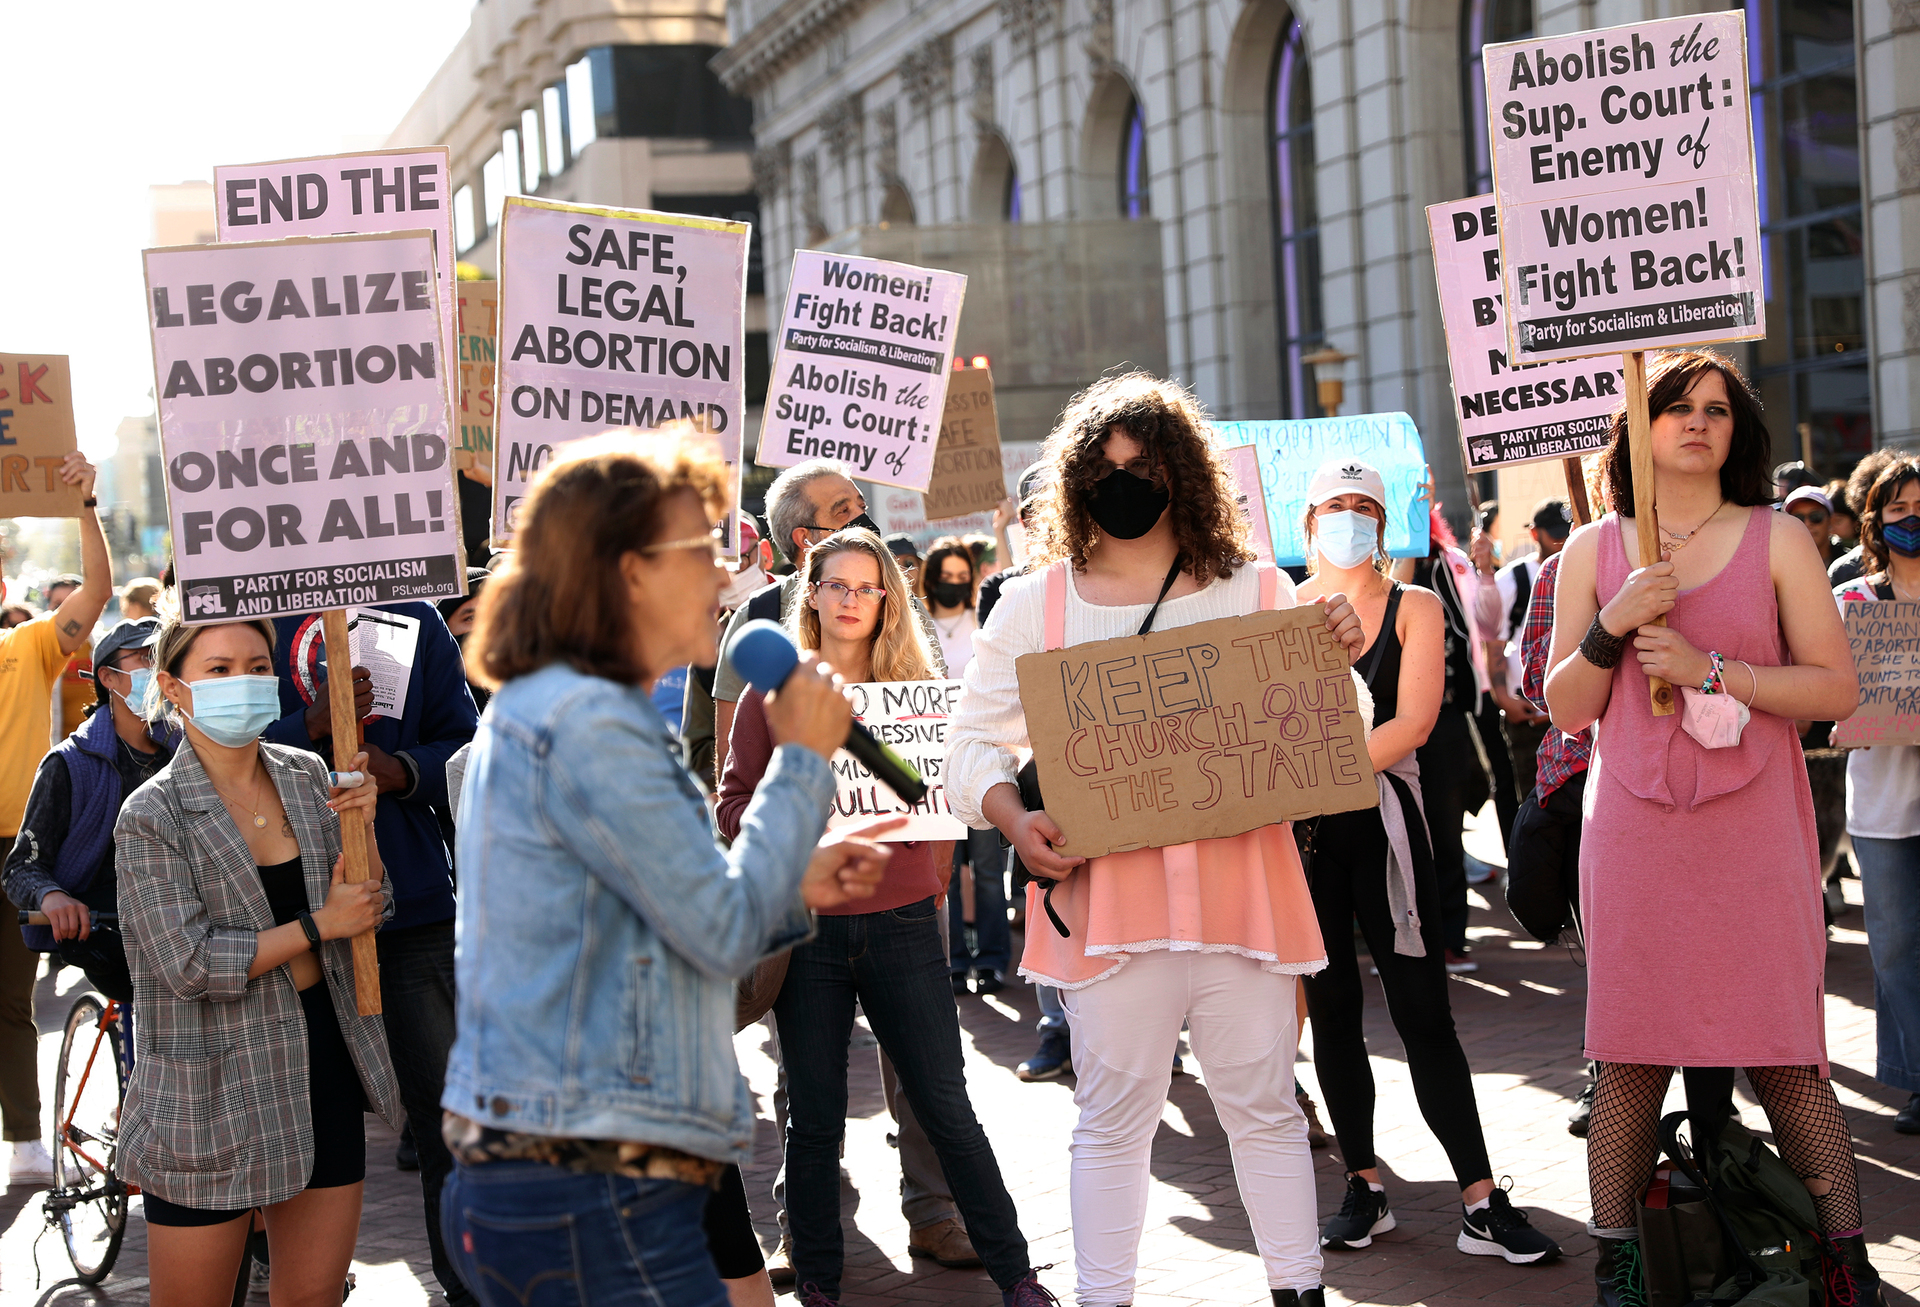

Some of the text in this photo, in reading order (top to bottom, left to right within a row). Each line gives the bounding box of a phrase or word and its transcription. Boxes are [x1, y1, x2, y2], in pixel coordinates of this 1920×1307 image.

[1509, 22, 1720, 91] Abolish the
[1502, 100, 1587, 142] Sup.
[1530, 116, 1710, 184] Enemy of
[226, 164, 439, 226] END THE
[1540, 187, 1708, 247] Women!
[565, 223, 687, 284] SAFE,
[1518, 237, 1745, 311] Fight Back!
[153, 270, 431, 328] LEGALIZE
[558, 274, 695, 328] LEGAL
[823, 260, 933, 303] Women!
[793, 293, 948, 342] Fight Back!
[1528, 300, 1744, 342] Party for Socialism & Liberation
[162, 342, 437, 399] ABORTION
[510, 324, 730, 382] ABORTION
[791, 331, 937, 367] Party for Socialism & Liberation
[511, 385, 728, 434] ON DEMAND
[787, 363, 929, 409] Abolish the
[776, 394, 832, 430] Sup.
[1500, 427, 1540, 445] PARTY
[1542, 424, 1566, 439] FOR
[170, 433, 447, 493] ONCE AND
[786, 428, 910, 477] Enemy of
[1473, 446, 1498, 462] PSL
[1503, 434, 1601, 460] AND LIBERATION
[182, 489, 445, 555] FOR ALL!
[188, 581, 454, 616] PSL AND LIBERATION PSLweb.org
[233, 561, 427, 595] PARTY FOR SOCIALISM
[1061, 624, 1341, 730] KEEP THE
[1871, 654, 1904, 665] SHE
[849, 685, 869, 717] O
[1262, 674, 1350, 719] OUT
[1837, 727, 1886, 743] STATE
[1089, 735, 1361, 821] THE STATE
